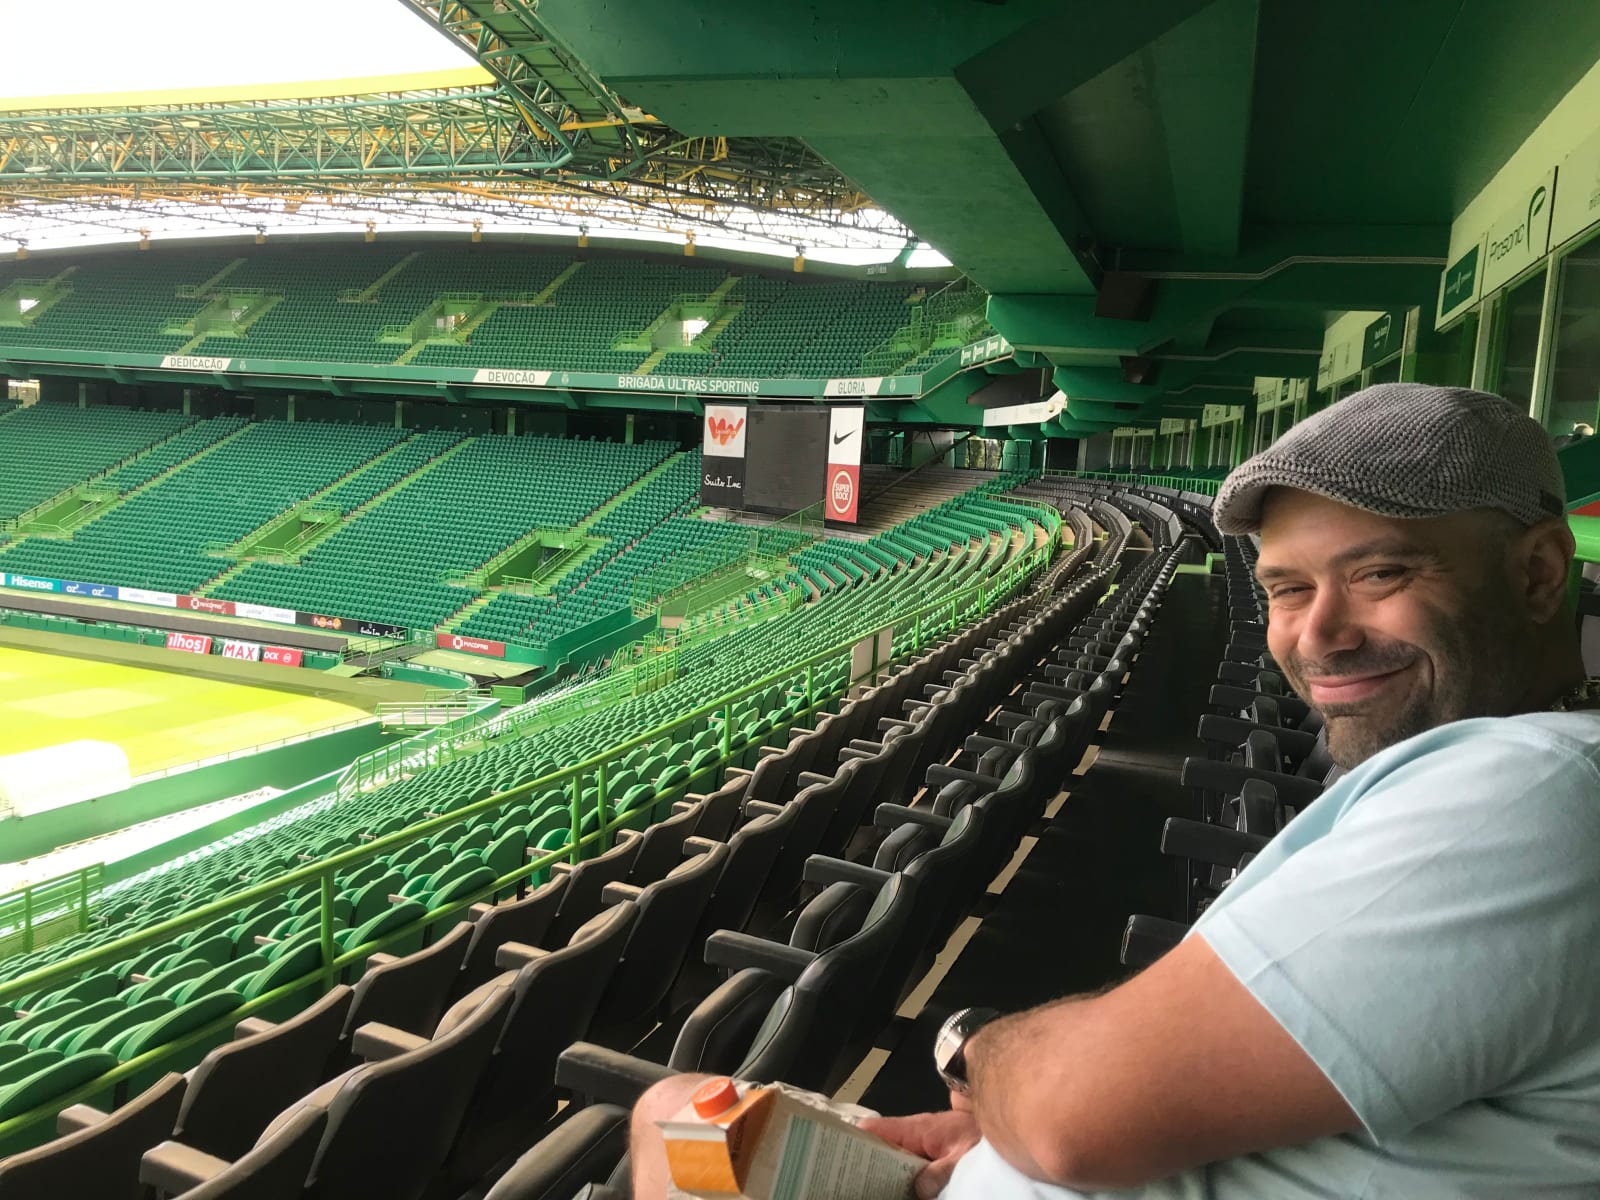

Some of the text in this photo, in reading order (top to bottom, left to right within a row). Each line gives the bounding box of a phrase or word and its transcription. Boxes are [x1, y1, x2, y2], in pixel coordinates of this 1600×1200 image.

[618, 376, 760, 394] BRIGADA ULTRAS SPORTING
[835, 483, 850, 492] SUPER
[835, 491, 849, 501] BOCK
[11, 575, 54, 590] Hisense
[224, 643, 256, 660] MAX
